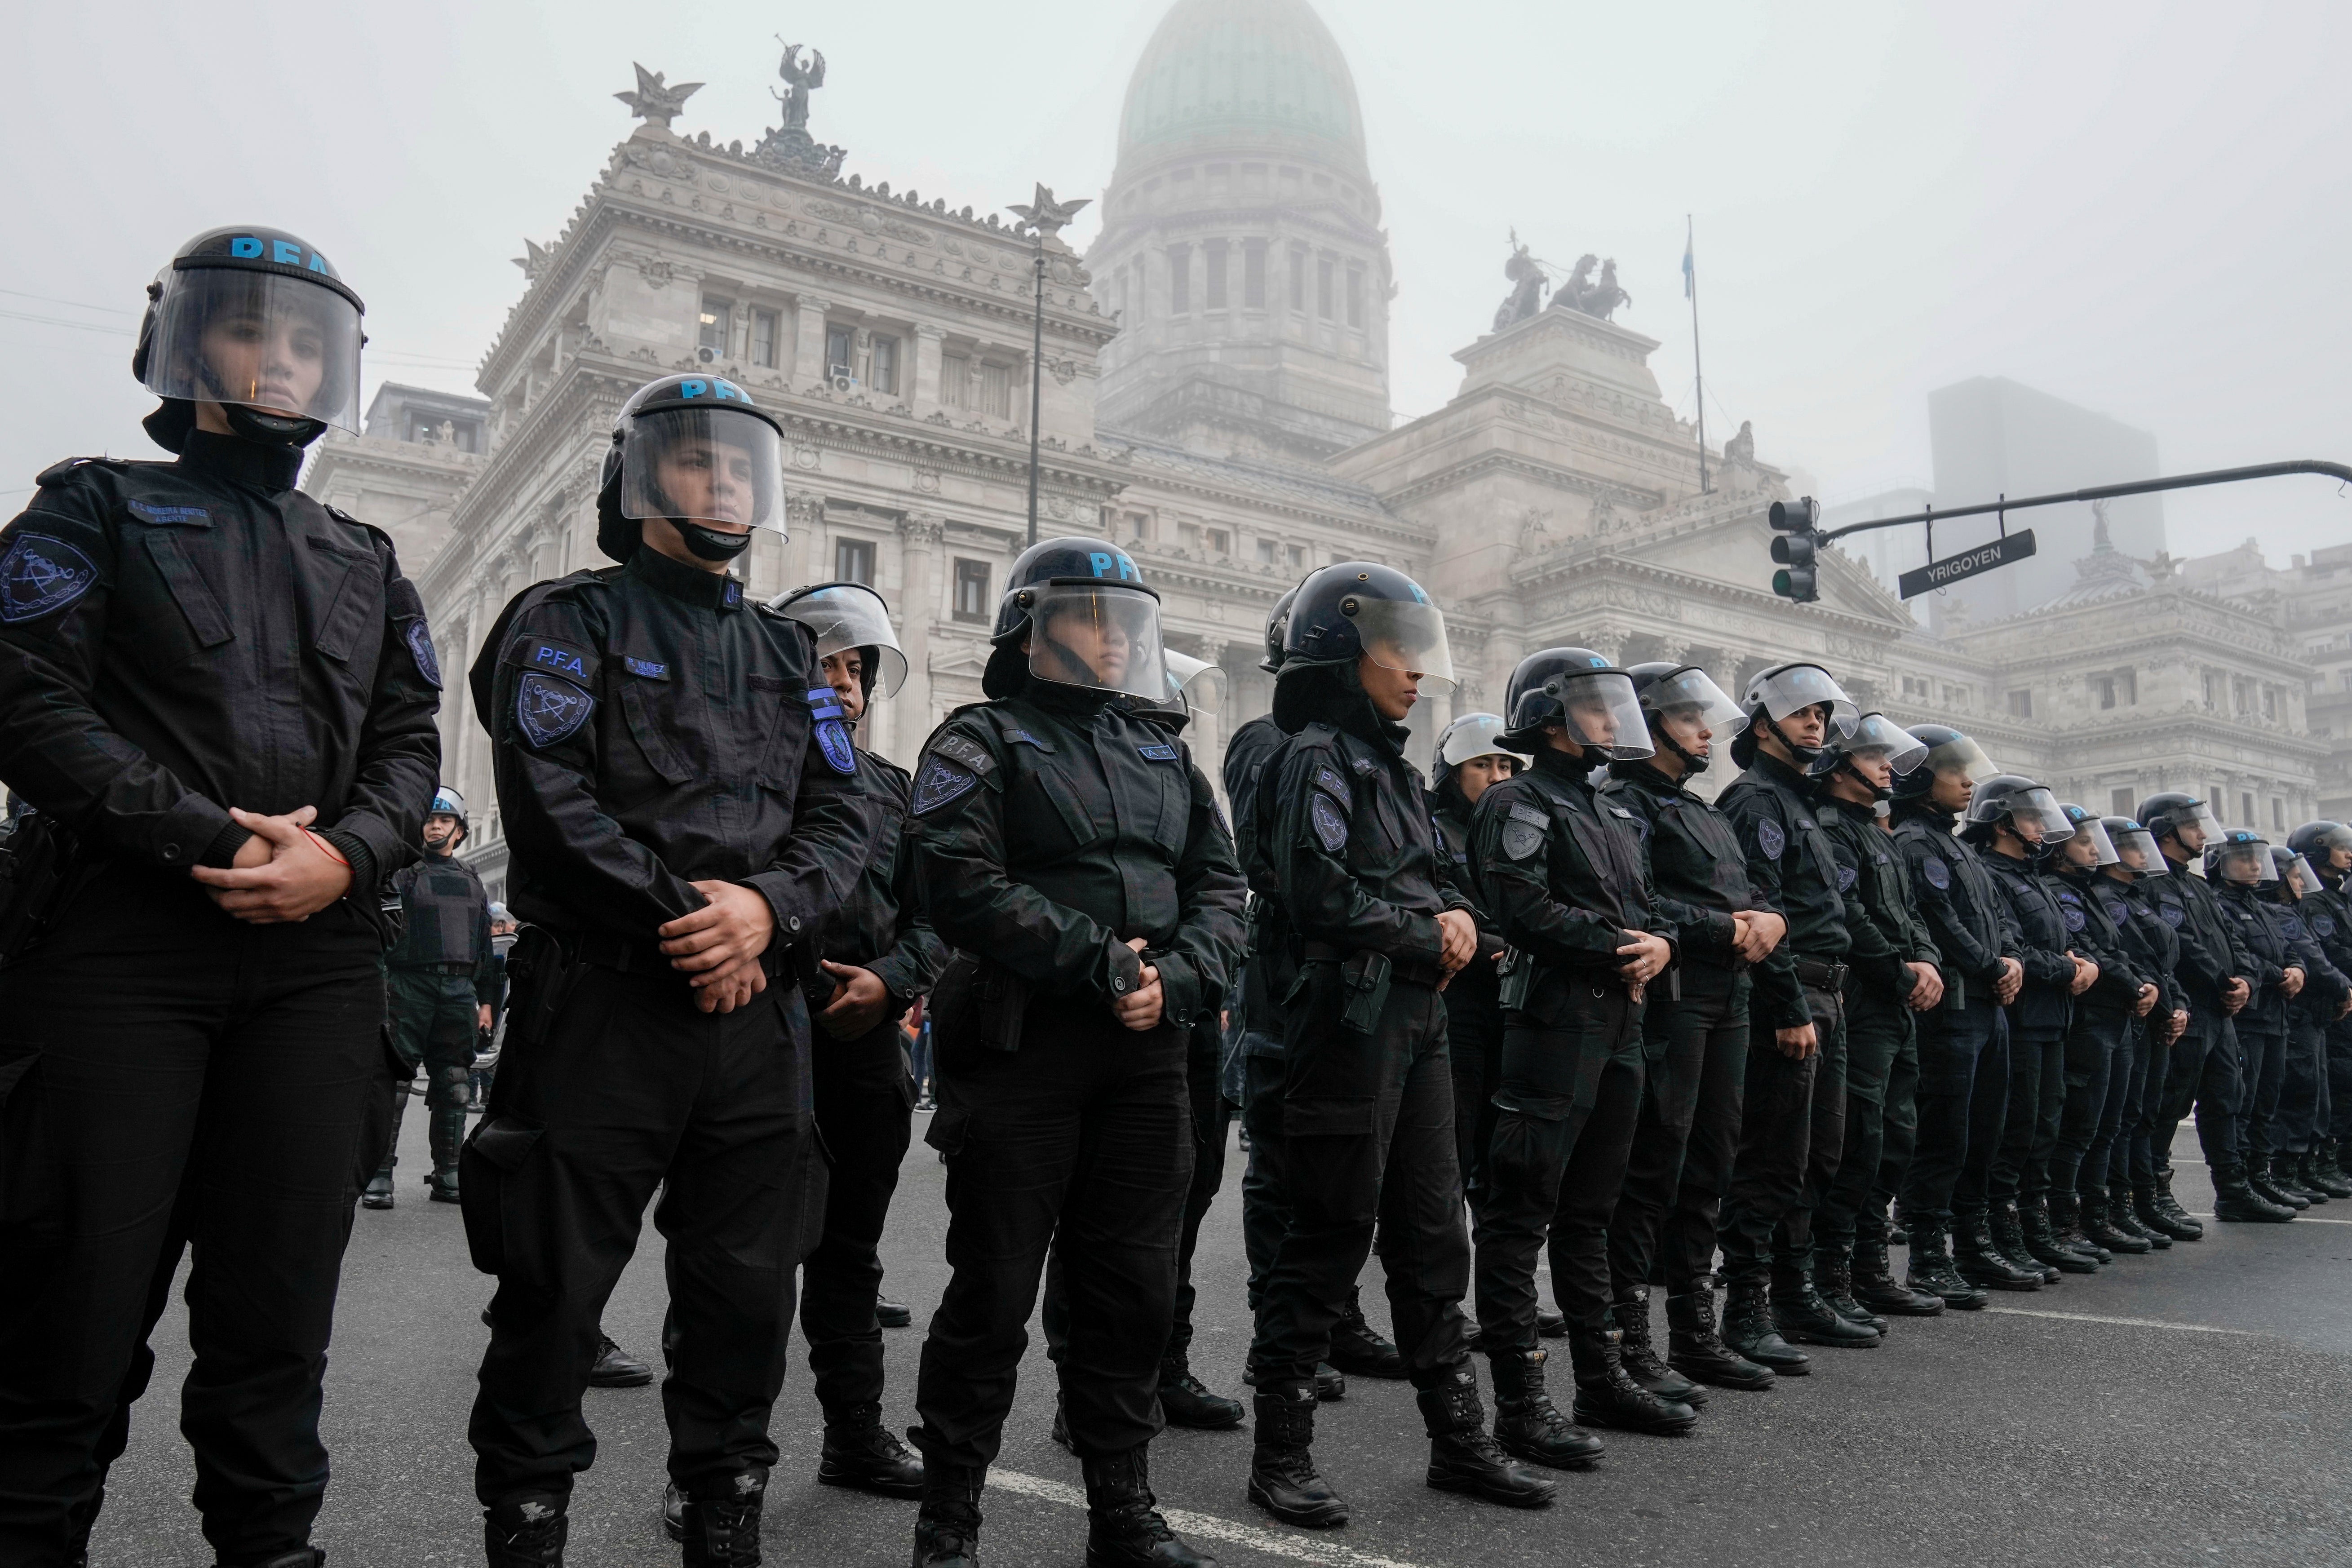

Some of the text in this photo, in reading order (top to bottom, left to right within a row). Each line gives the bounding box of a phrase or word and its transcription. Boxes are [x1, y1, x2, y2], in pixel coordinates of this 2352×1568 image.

[1089, 552, 1143, 583] PF
[1927, 545, 2001, 583] YRIGOYEN
[536, 646, 588, 678] P.F.A.
[941, 736, 987, 770] P.F.A.
[433, 797, 451, 810] FA
